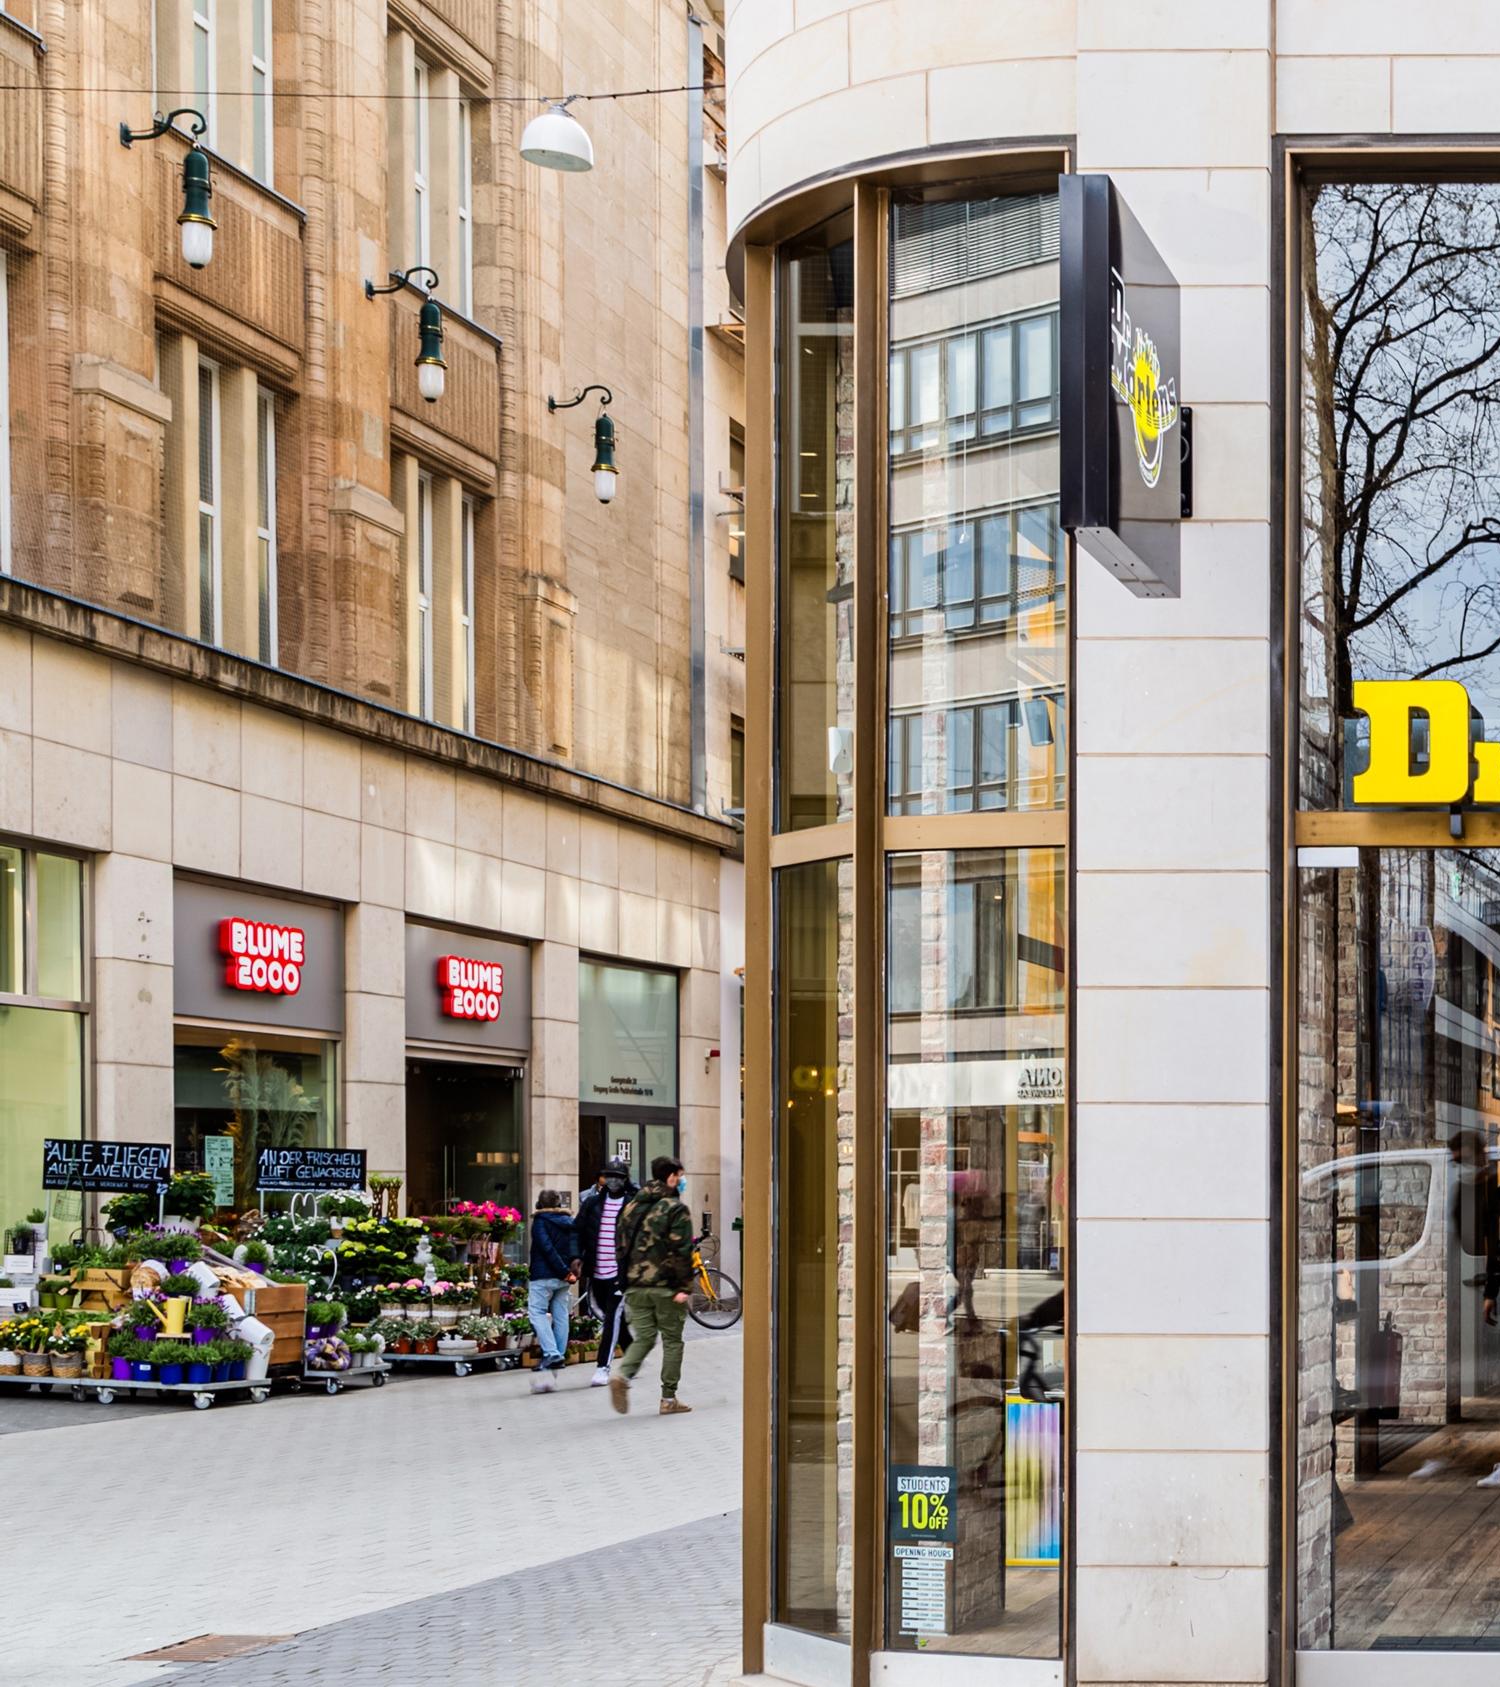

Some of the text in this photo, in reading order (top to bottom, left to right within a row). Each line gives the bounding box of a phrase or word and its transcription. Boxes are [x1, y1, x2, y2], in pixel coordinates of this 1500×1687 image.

[231, 920, 304, 963] BLUME
[237, 955, 300, 993] 2000
[448, 958, 503, 993] BLUME
[452, 989, 500, 1019] 2000
[46, 1142, 170, 1168] ALLE FLIEGEN
[258, 1149, 361, 1166] AN DER FRISCHEN
[47, 1162, 163, 1180] AUF LAVENDEL
[261, 1165, 361, 1179] LUFT GEWACHSEN
[900, 1478, 947, 1492] STUDENTS
[898, 1492, 949, 1530] 10%
[928, 1516, 949, 1530] OFF
[895, 1547, 952, 1558] OPENING HOURS
